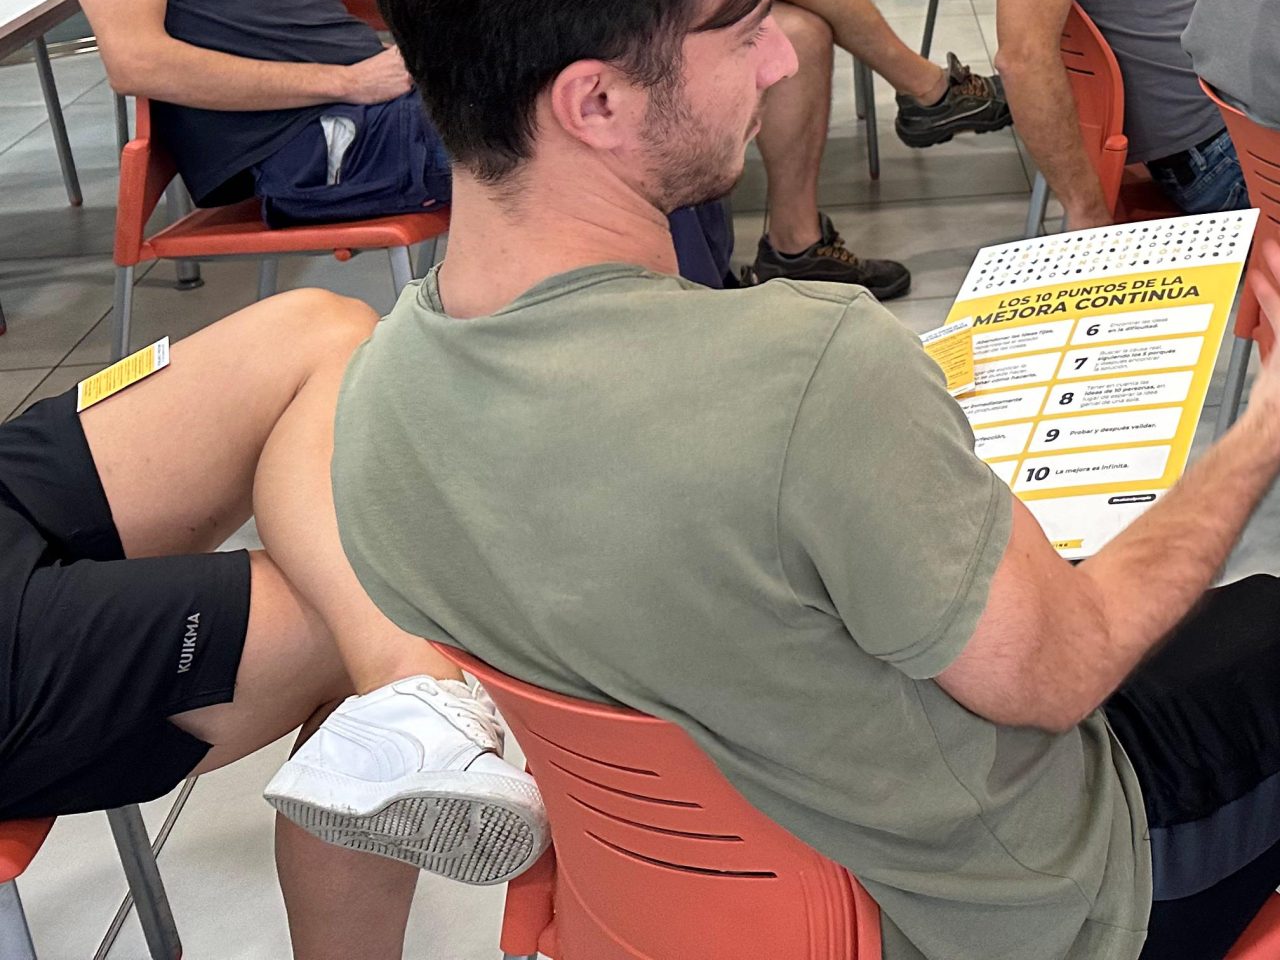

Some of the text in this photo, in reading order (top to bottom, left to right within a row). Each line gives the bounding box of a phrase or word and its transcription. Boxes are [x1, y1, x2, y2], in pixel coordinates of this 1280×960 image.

[998, 275, 1184, 309] LOS 10 PUNTOS DE LA
[972, 285, 1200, 328] MEJORA CONTINUA
[1086, 323, 1101, 337] 6
[1074, 356, 1089, 370] 7
[1058, 392, 1075, 406] 8
[1044, 428, 1060, 443] 9
[1025, 466, 1051, 483] 10
[176, 611, 201, 675] KUIKMA
